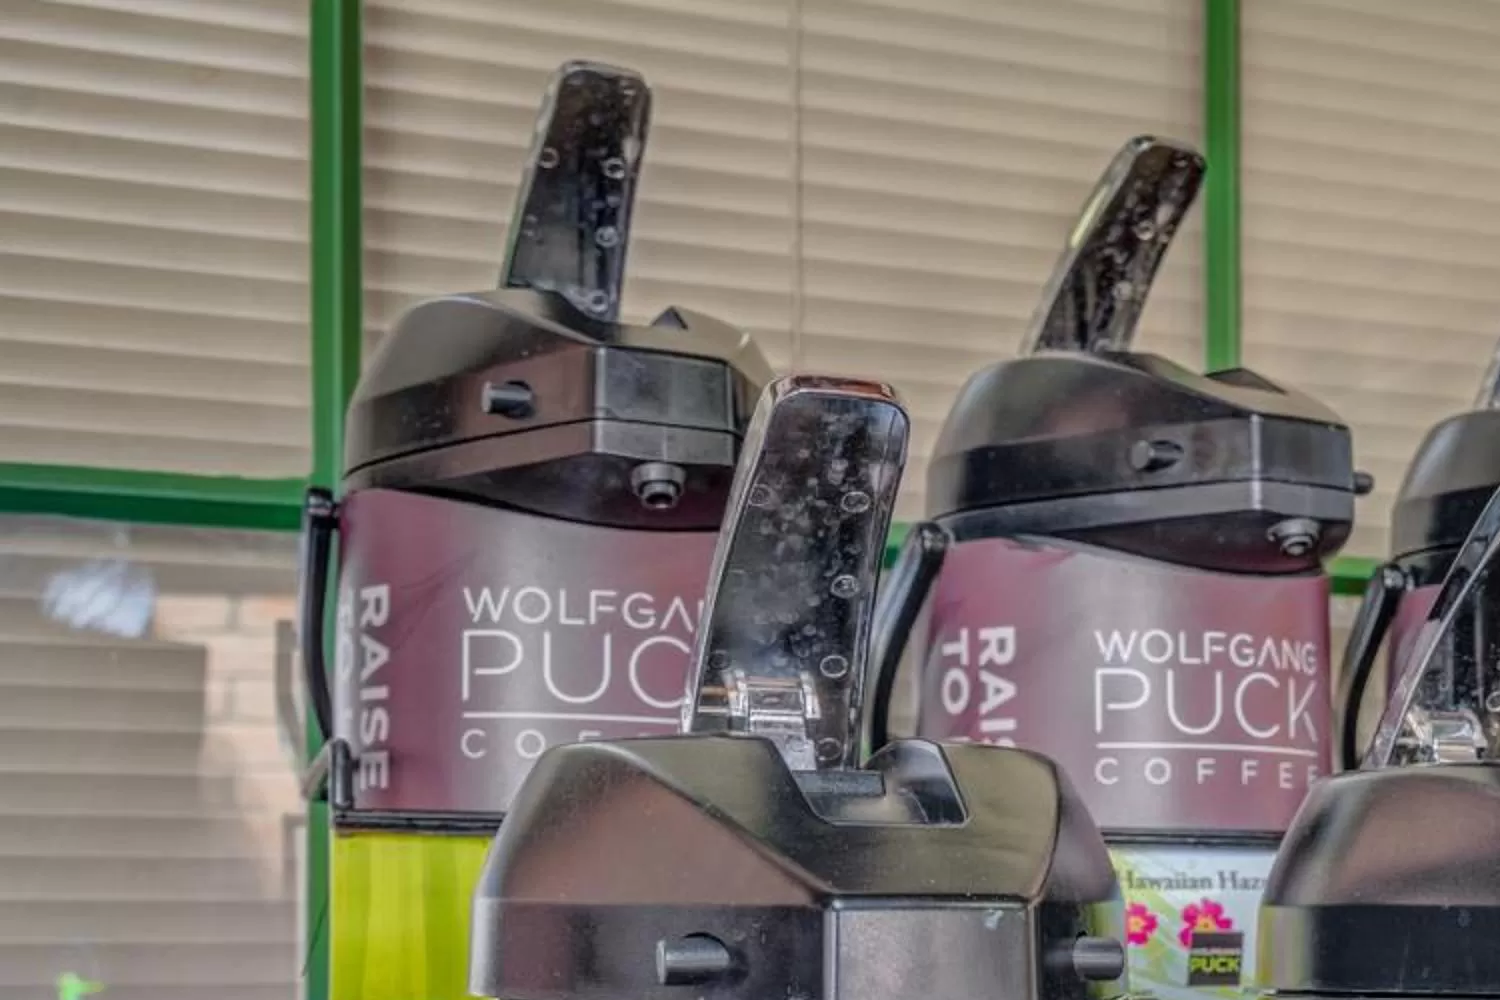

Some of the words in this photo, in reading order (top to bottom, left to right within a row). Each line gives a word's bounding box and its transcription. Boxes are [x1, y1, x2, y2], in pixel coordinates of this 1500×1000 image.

[359, 583, 390, 790] RAISE
[941, 628, 969, 715] TO
[1094, 628, 1318, 674] WOLFGANG
[1096, 667, 1319, 744] PUCK
